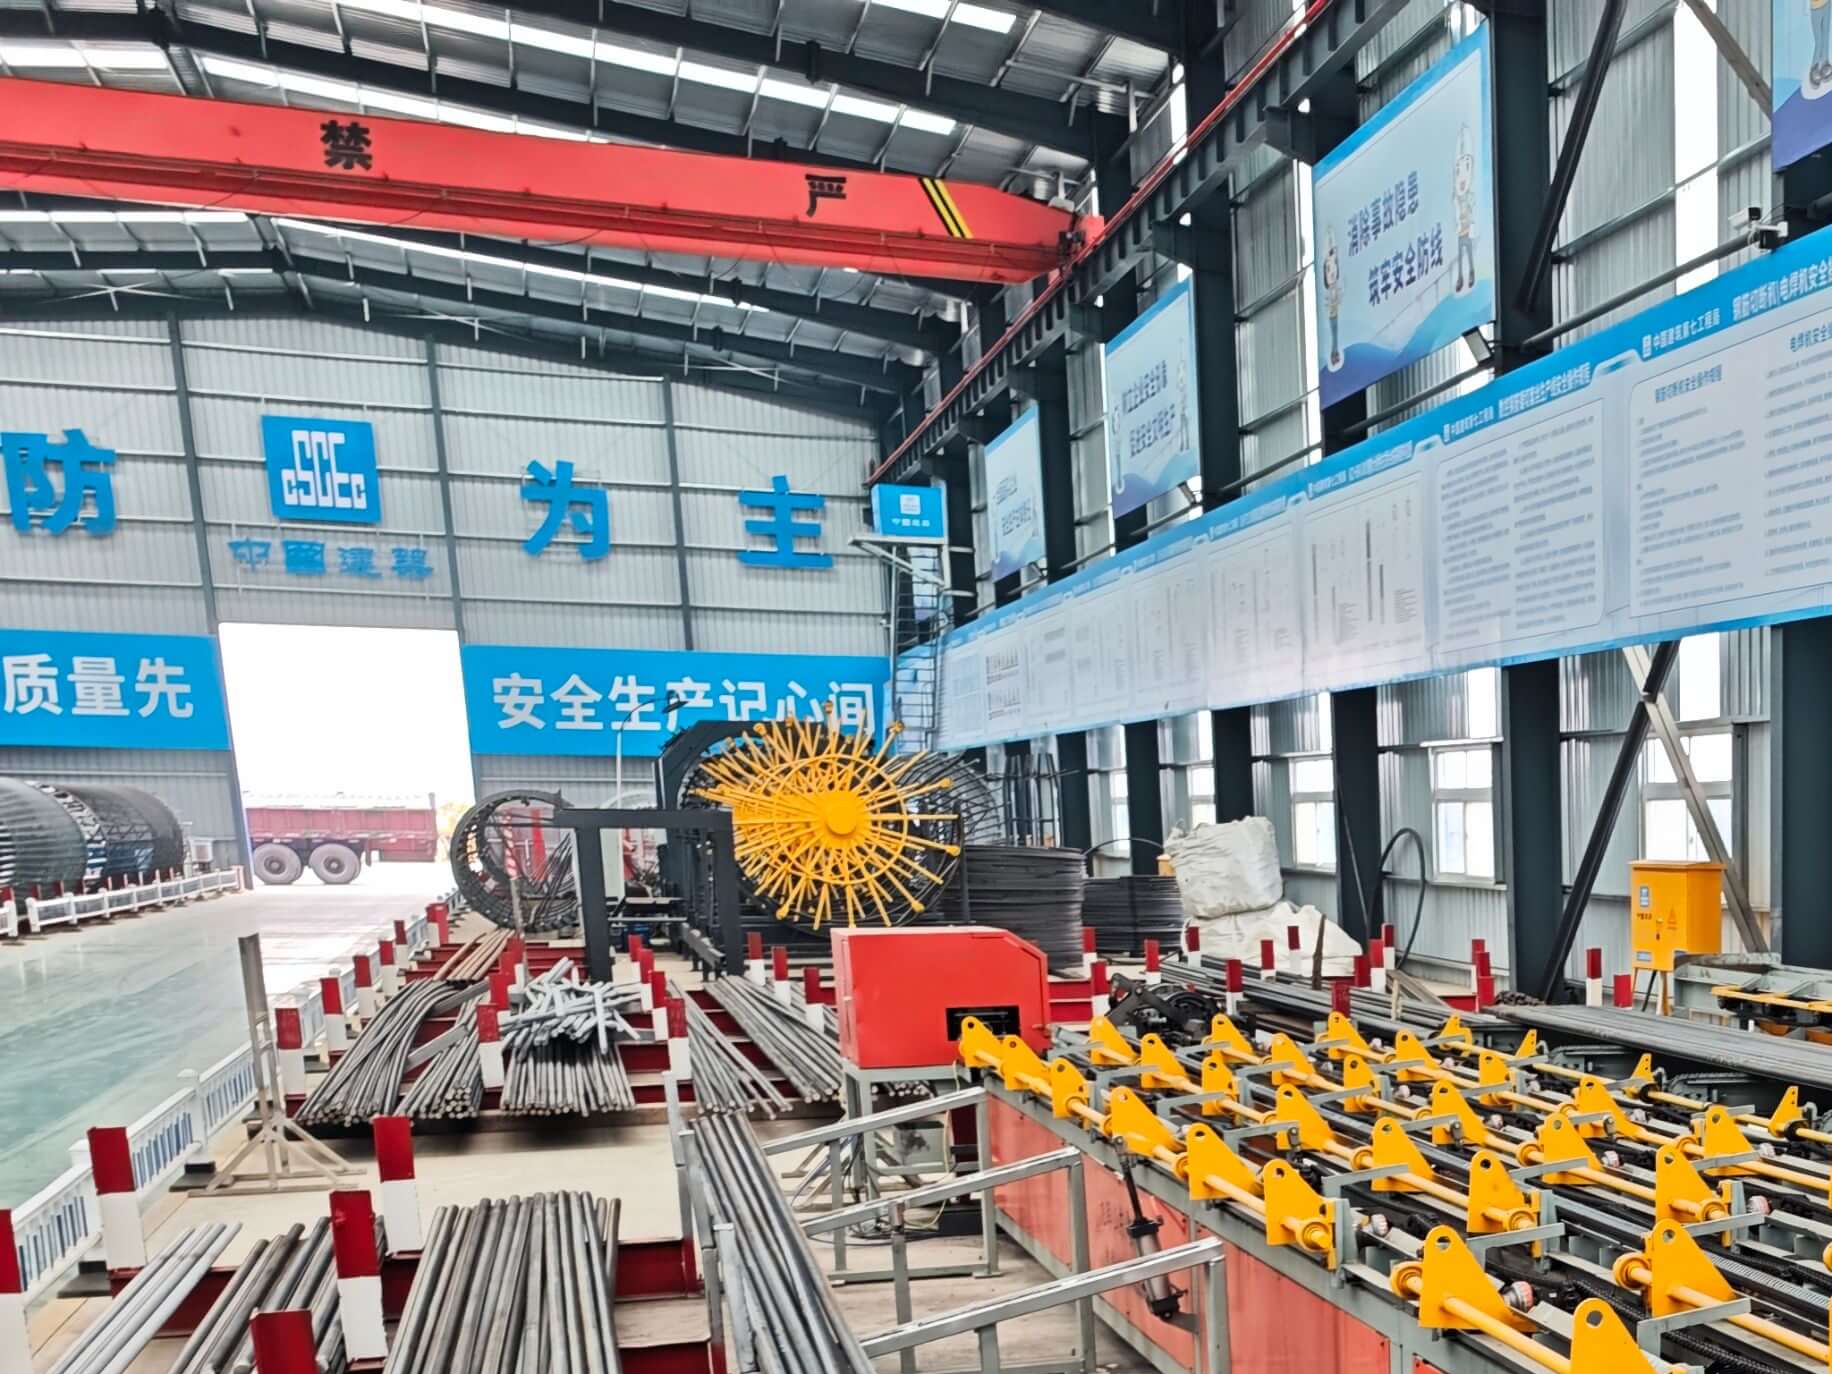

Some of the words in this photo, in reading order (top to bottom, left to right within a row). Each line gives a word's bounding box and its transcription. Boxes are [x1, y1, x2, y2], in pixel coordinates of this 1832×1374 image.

[320, 118, 373, 171] 禁
[804, 174, 848, 217] 严
[0, 428, 117, 536] 防
[520, 458, 611, 562] 为
[737, 474, 835, 569] 主
[2, 653, 195, 719] 质量先
[492, 672, 876, 735] 安全生产记心间
